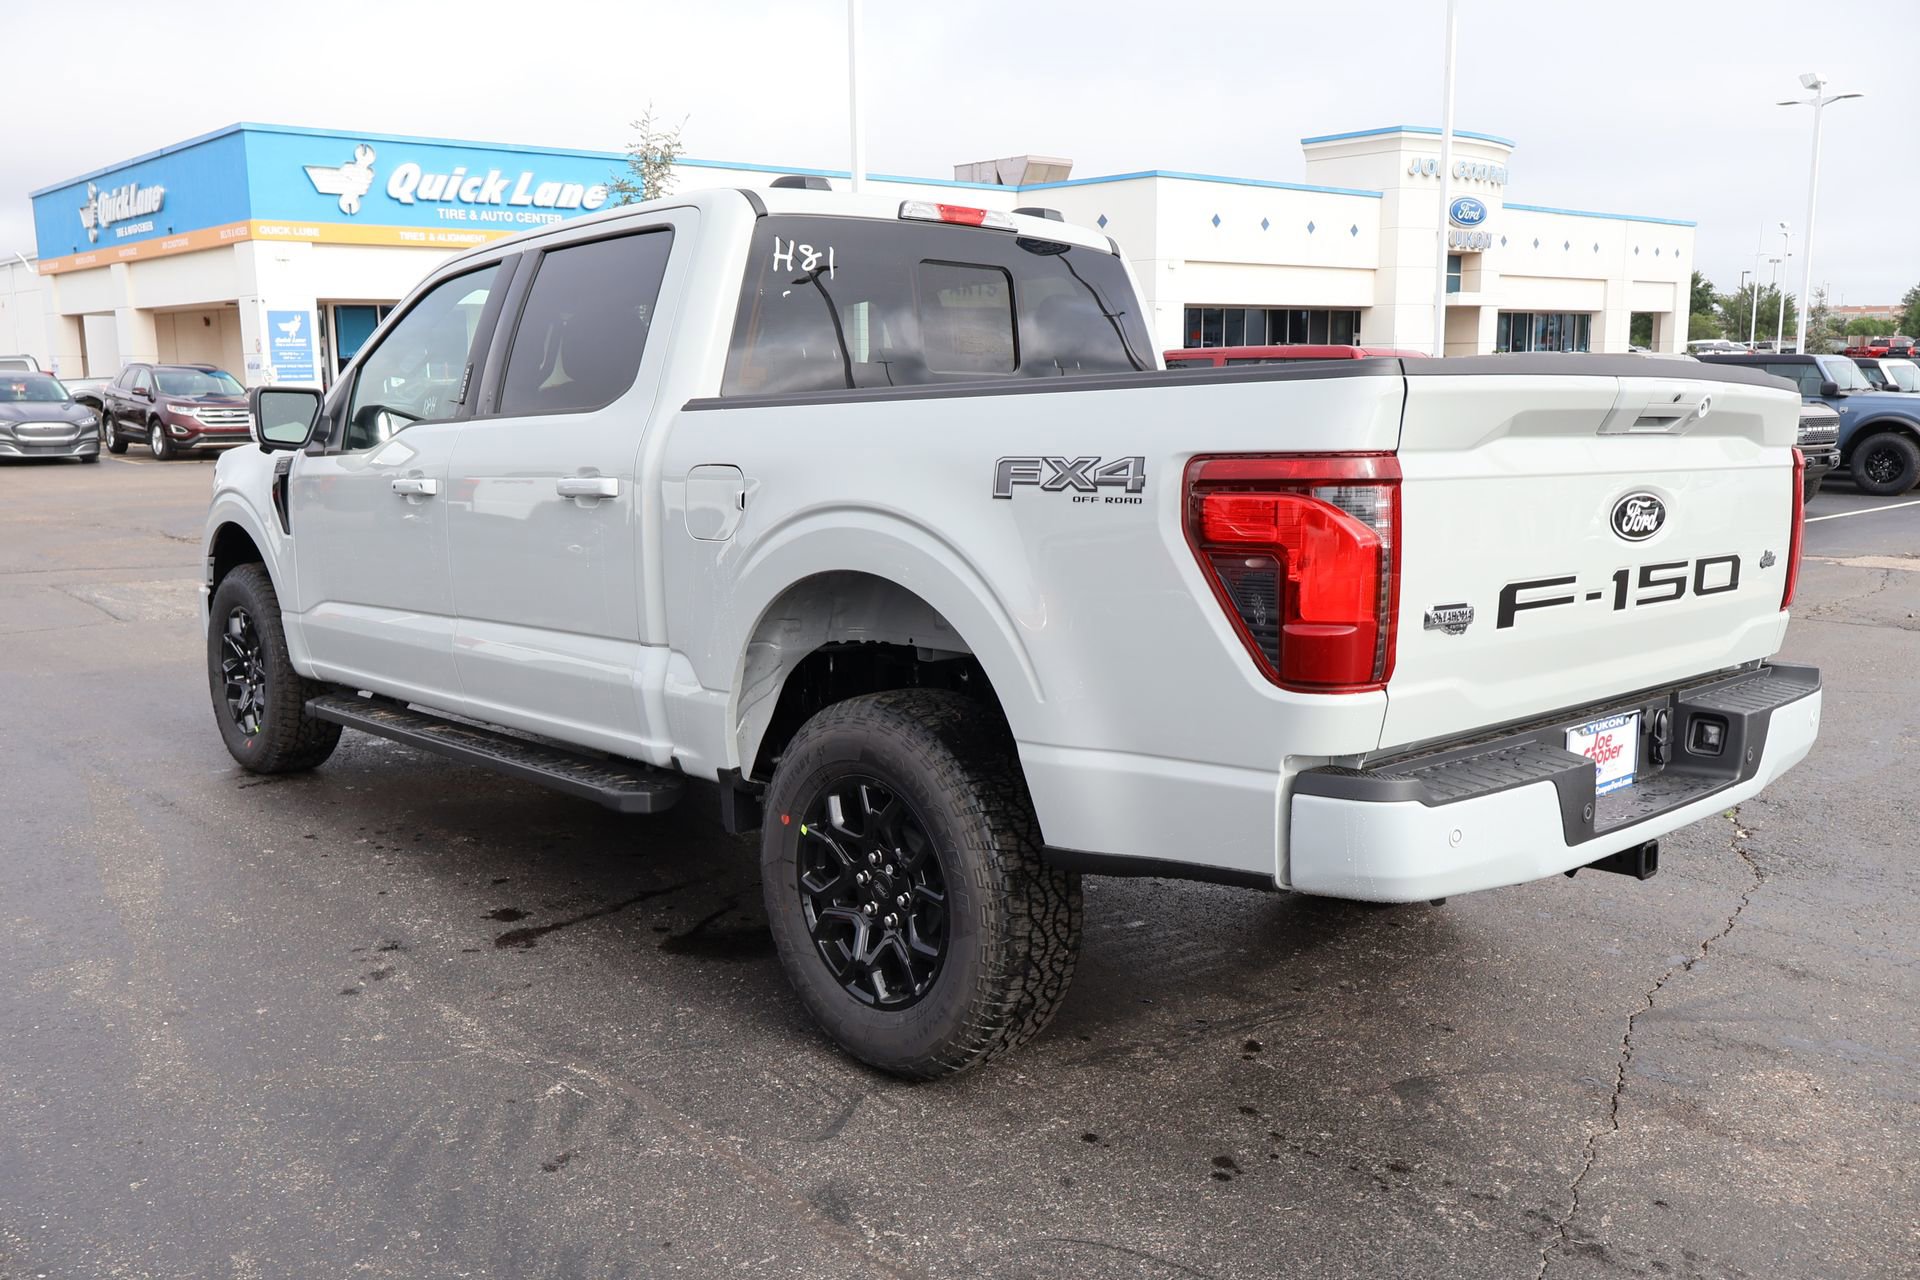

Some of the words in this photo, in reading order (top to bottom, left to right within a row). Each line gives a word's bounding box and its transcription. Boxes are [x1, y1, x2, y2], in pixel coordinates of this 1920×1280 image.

[387, 163, 509, 205] Quick
[507, 171, 608, 209] Lane
[98, 185, 130, 227] Quick
[130, 183, 164, 216] Lane
[437, 208, 465, 220] TIRE
[469, 209, 477, 220] &
[480, 210, 513, 222] AUTO
[515, 212, 563, 224] CENTER
[259, 226, 291, 236] QUICK
[294, 227, 320, 237] LUBE
[400, 232, 425, 240] TIRES
[429, 233, 435, 241] &
[437, 233, 487, 242] ALIGNMENT
[1437, 230, 1491, 250] UKON
[773, 236, 834, 280] H81
[993, 456, 1145, 499] FX4
[1105, 497, 1142, 505] ROAD
[1621, 499, 1659, 533] Ford
[1496, 554, 1740, 629] F-150
[1589, 716, 1624, 733] YUKON
[1591, 733, 1612, 751] Joe
